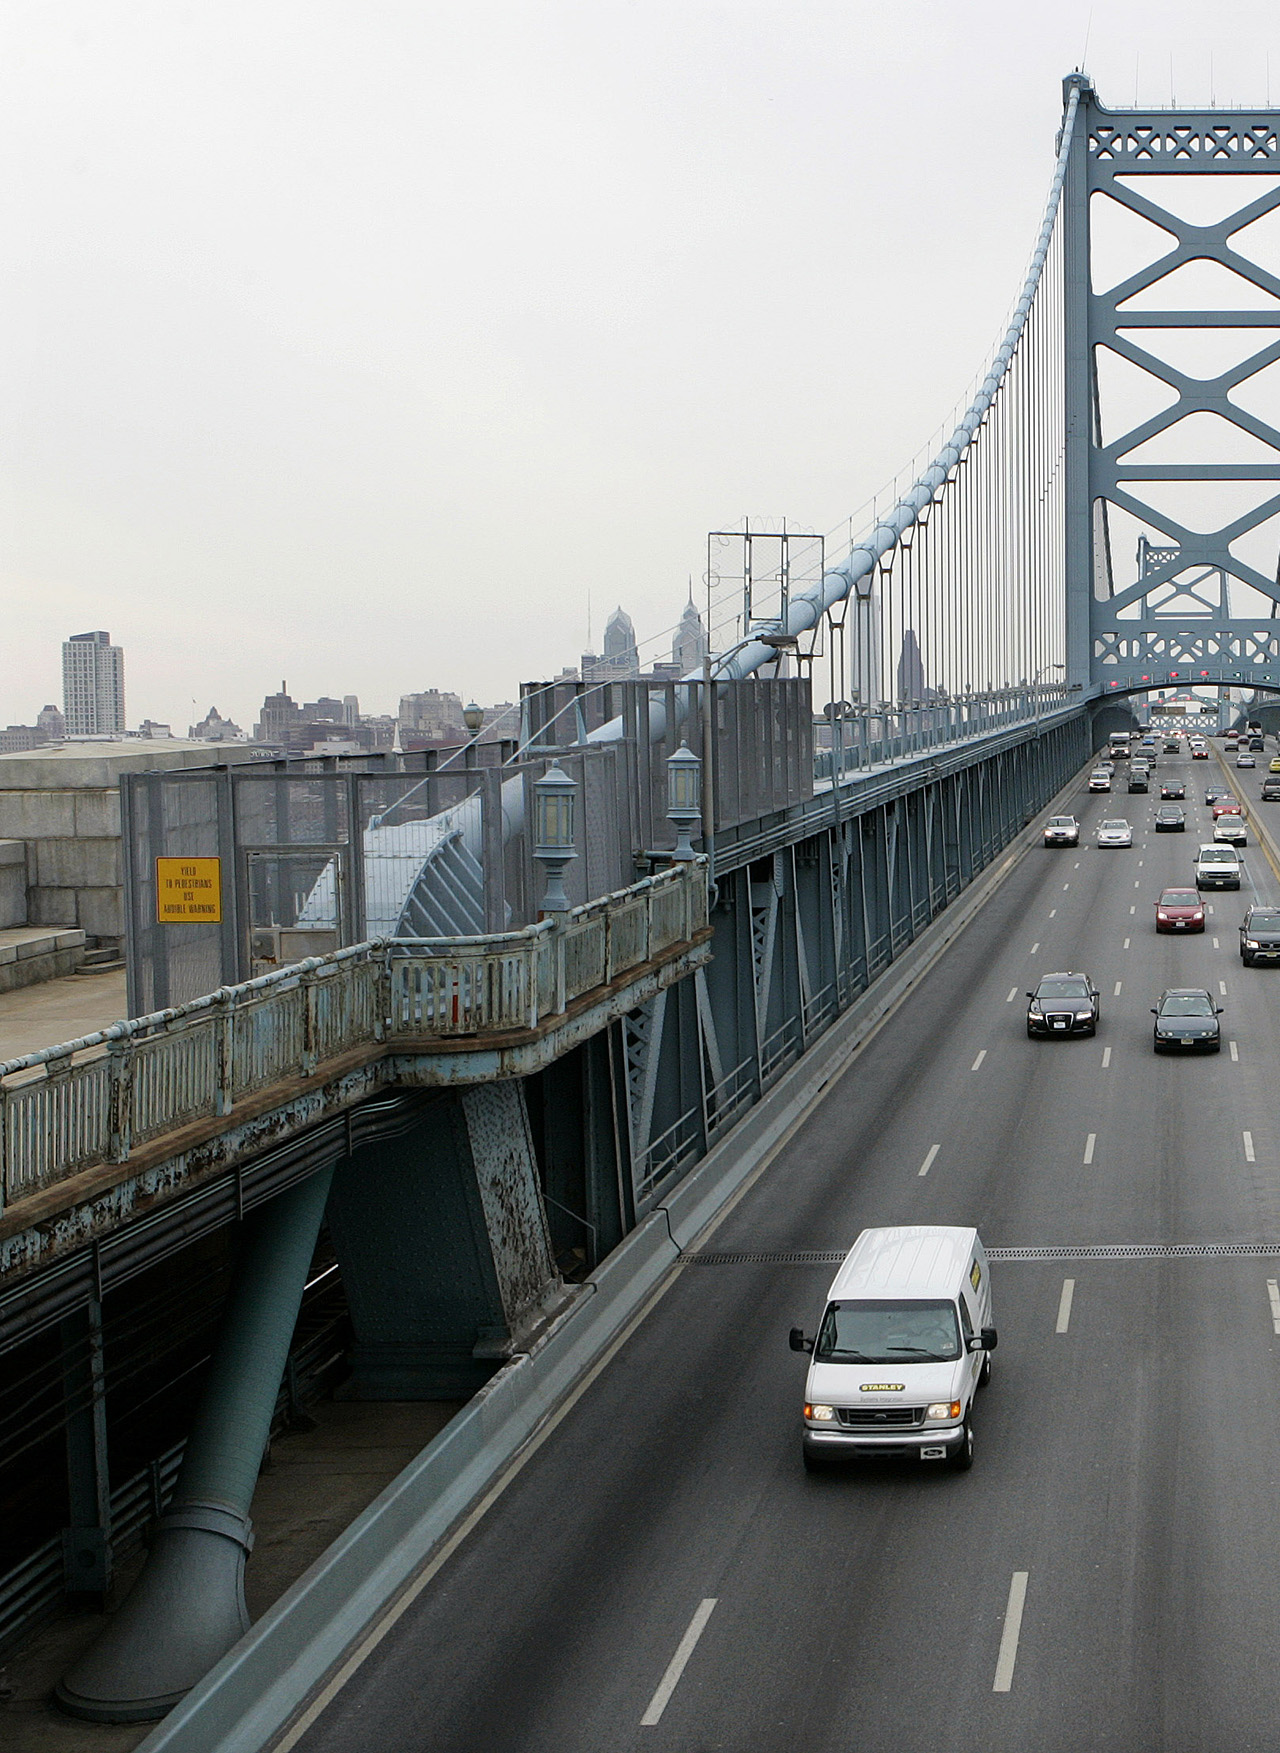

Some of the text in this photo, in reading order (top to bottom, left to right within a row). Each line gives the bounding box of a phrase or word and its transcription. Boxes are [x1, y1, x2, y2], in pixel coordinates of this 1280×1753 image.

[181, 866, 197, 876] YIELD
[166, 879, 212, 889] TO PEDESTRIANS
[183, 892, 194, 901] USE
[164, 904, 216, 914] AUDIBLE WARNING
